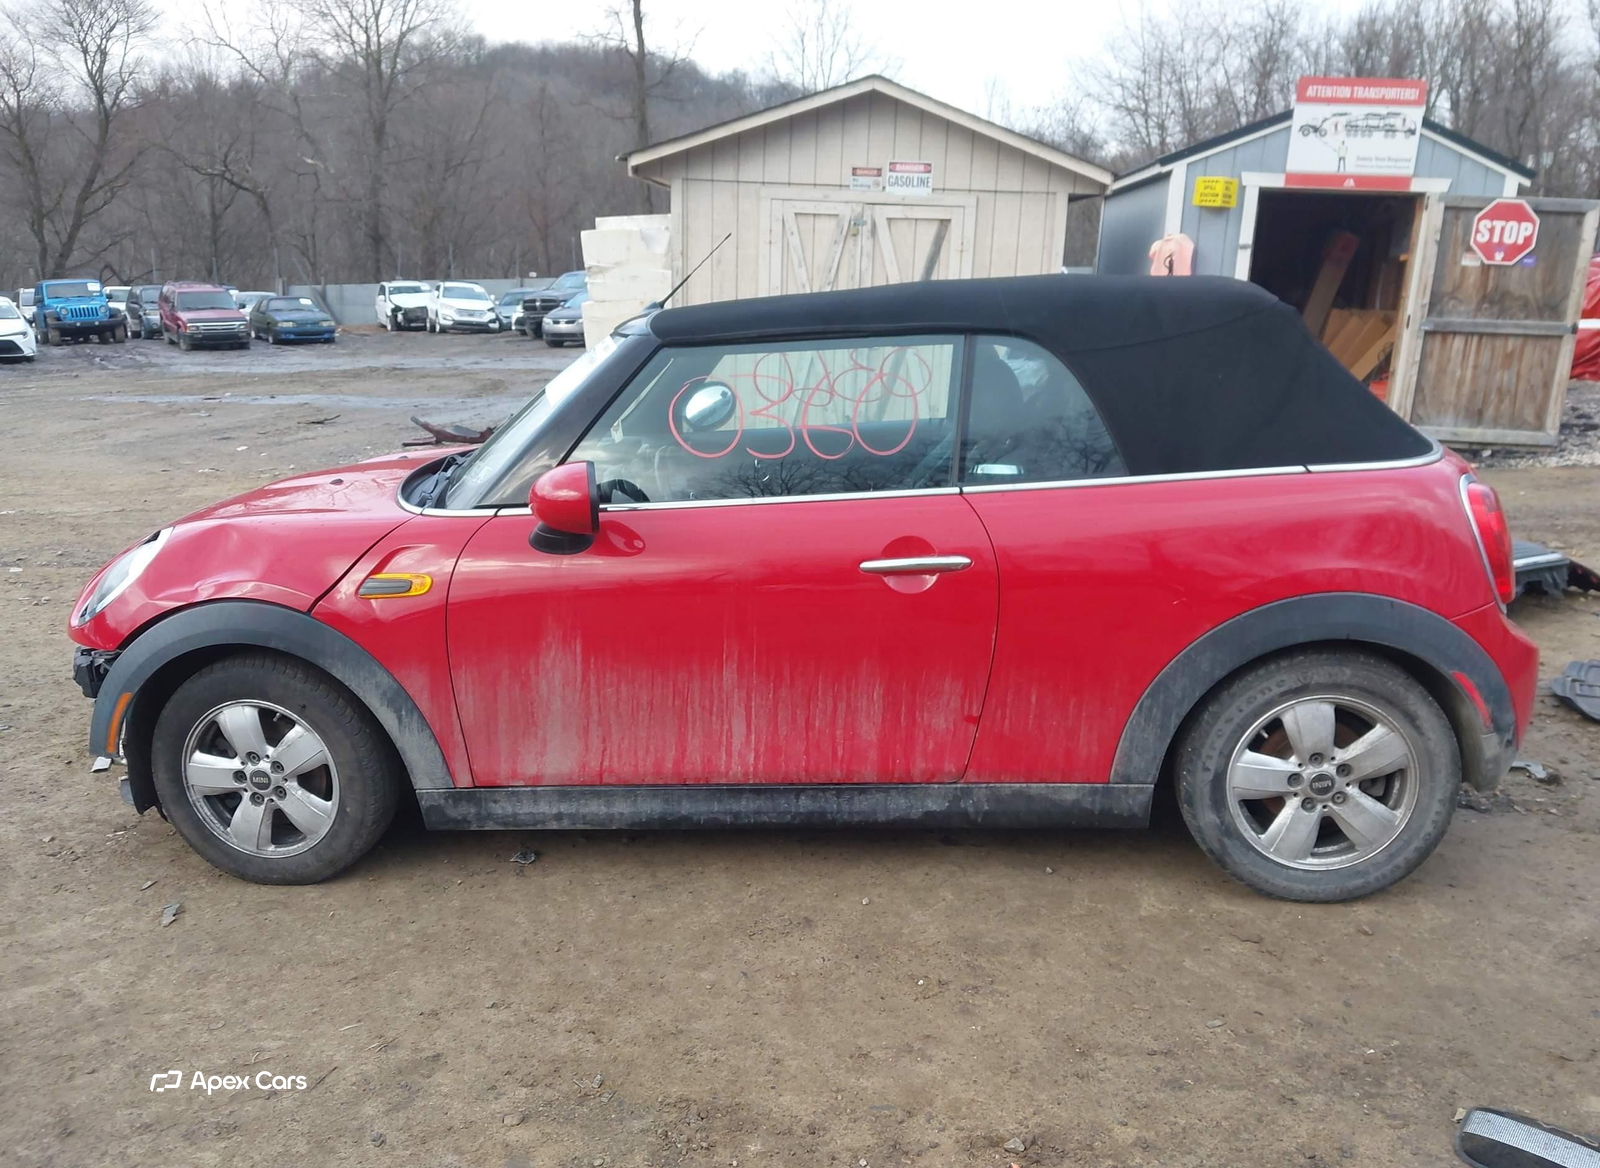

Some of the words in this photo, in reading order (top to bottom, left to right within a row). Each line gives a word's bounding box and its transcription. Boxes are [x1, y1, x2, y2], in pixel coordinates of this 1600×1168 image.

[1306, 85, 1352, 99] ATTENTION
[1353, 86, 1419, 101] TRANSPORTERS!
[895, 163, 925, 171] DANGER
[887, 175, 931, 189] GASOLINE
[1476, 219, 1534, 245] STOP
[668, 372, 918, 459] 0360
